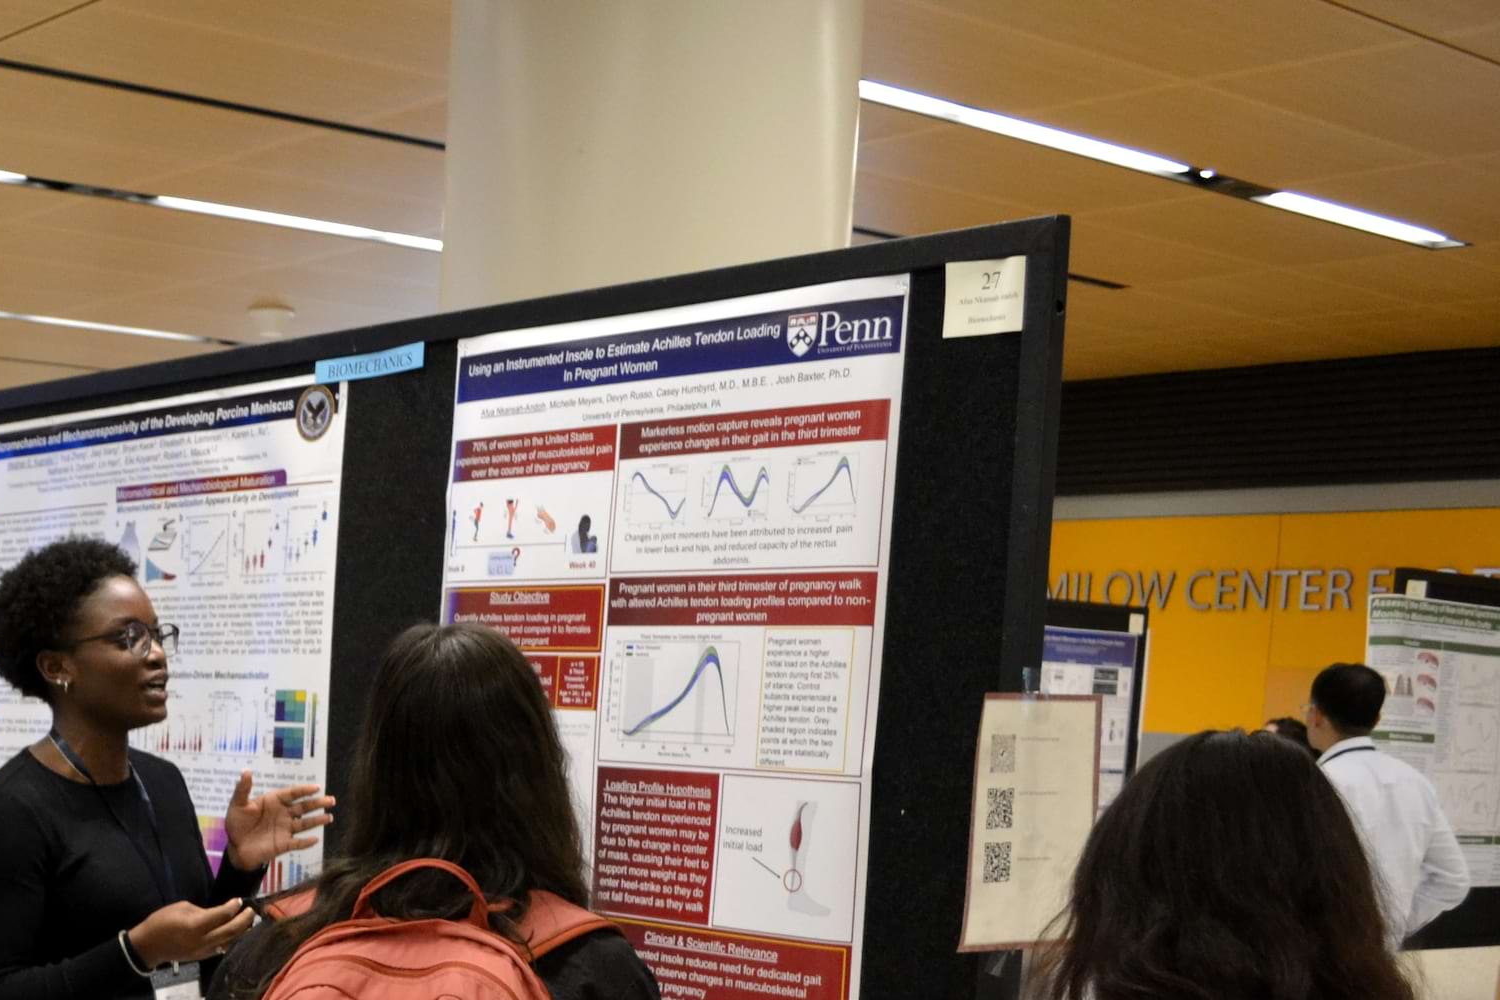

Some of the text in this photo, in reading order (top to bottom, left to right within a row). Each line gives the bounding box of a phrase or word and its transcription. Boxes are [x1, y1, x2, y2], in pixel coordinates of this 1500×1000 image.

[982, 271, 1001, 290] 27
[818, 311, 892, 346] Penn
[469, 324, 780, 378] Using an Instrumented Insole to Estimate Achilles Tendon Loading
[328, 352, 412, 378] BIOMECHANICS
[564, 360, 658, 382] In Pregnant Women
[776, 374, 795, 384] Josh
[140, 420, 149, 431] of
[150, 417, 164, 428] the
[165, 407, 214, 428] Developing
[217, 405, 249, 421] Porcine
[251, 399, 293, 417] Meniscus
[641, 410, 861, 438] Markerless motion capture reveals pregnant women
[639, 424, 861, 453] experience changes in their gait in the third trimester
[619, 578, 861, 595] Pregnant women in their third trimester of pregnancy walk
[1186, 569, 1353, 611] CENTER
[490, 592, 549, 603] Study Objective
[611, 594, 870, 608] with altered Achilles tendon loading profiles compared to non-
[697, 611, 767, 624] pregnant women
[605, 780, 711, 797] Loading Profile Hypothesis
[603, 793, 710, 811] The higher initial load in the
[601, 807, 711, 826] Achilles tendon experienced
[601, 821, 708, 841] by pregnant women may be
[725, 826, 762, 837] Increased
[602, 836, 708, 854] due to the change in center
[723, 841, 762, 852] initial load
[644, 931, 778, 961] Clinical & Scientific Relevance
[661, 951, 684, 964] insole
[686, 953, 718, 970] reduces
[720, 960, 741, 974] need
[743, 964, 755, 976] for
[757, 967, 800, 983] dedicated
[803, 974, 821, 986] gait
[656, 965, 807, 999] observe changes in musculoskeletal
[665, 982, 706, 1000] pregnancy
